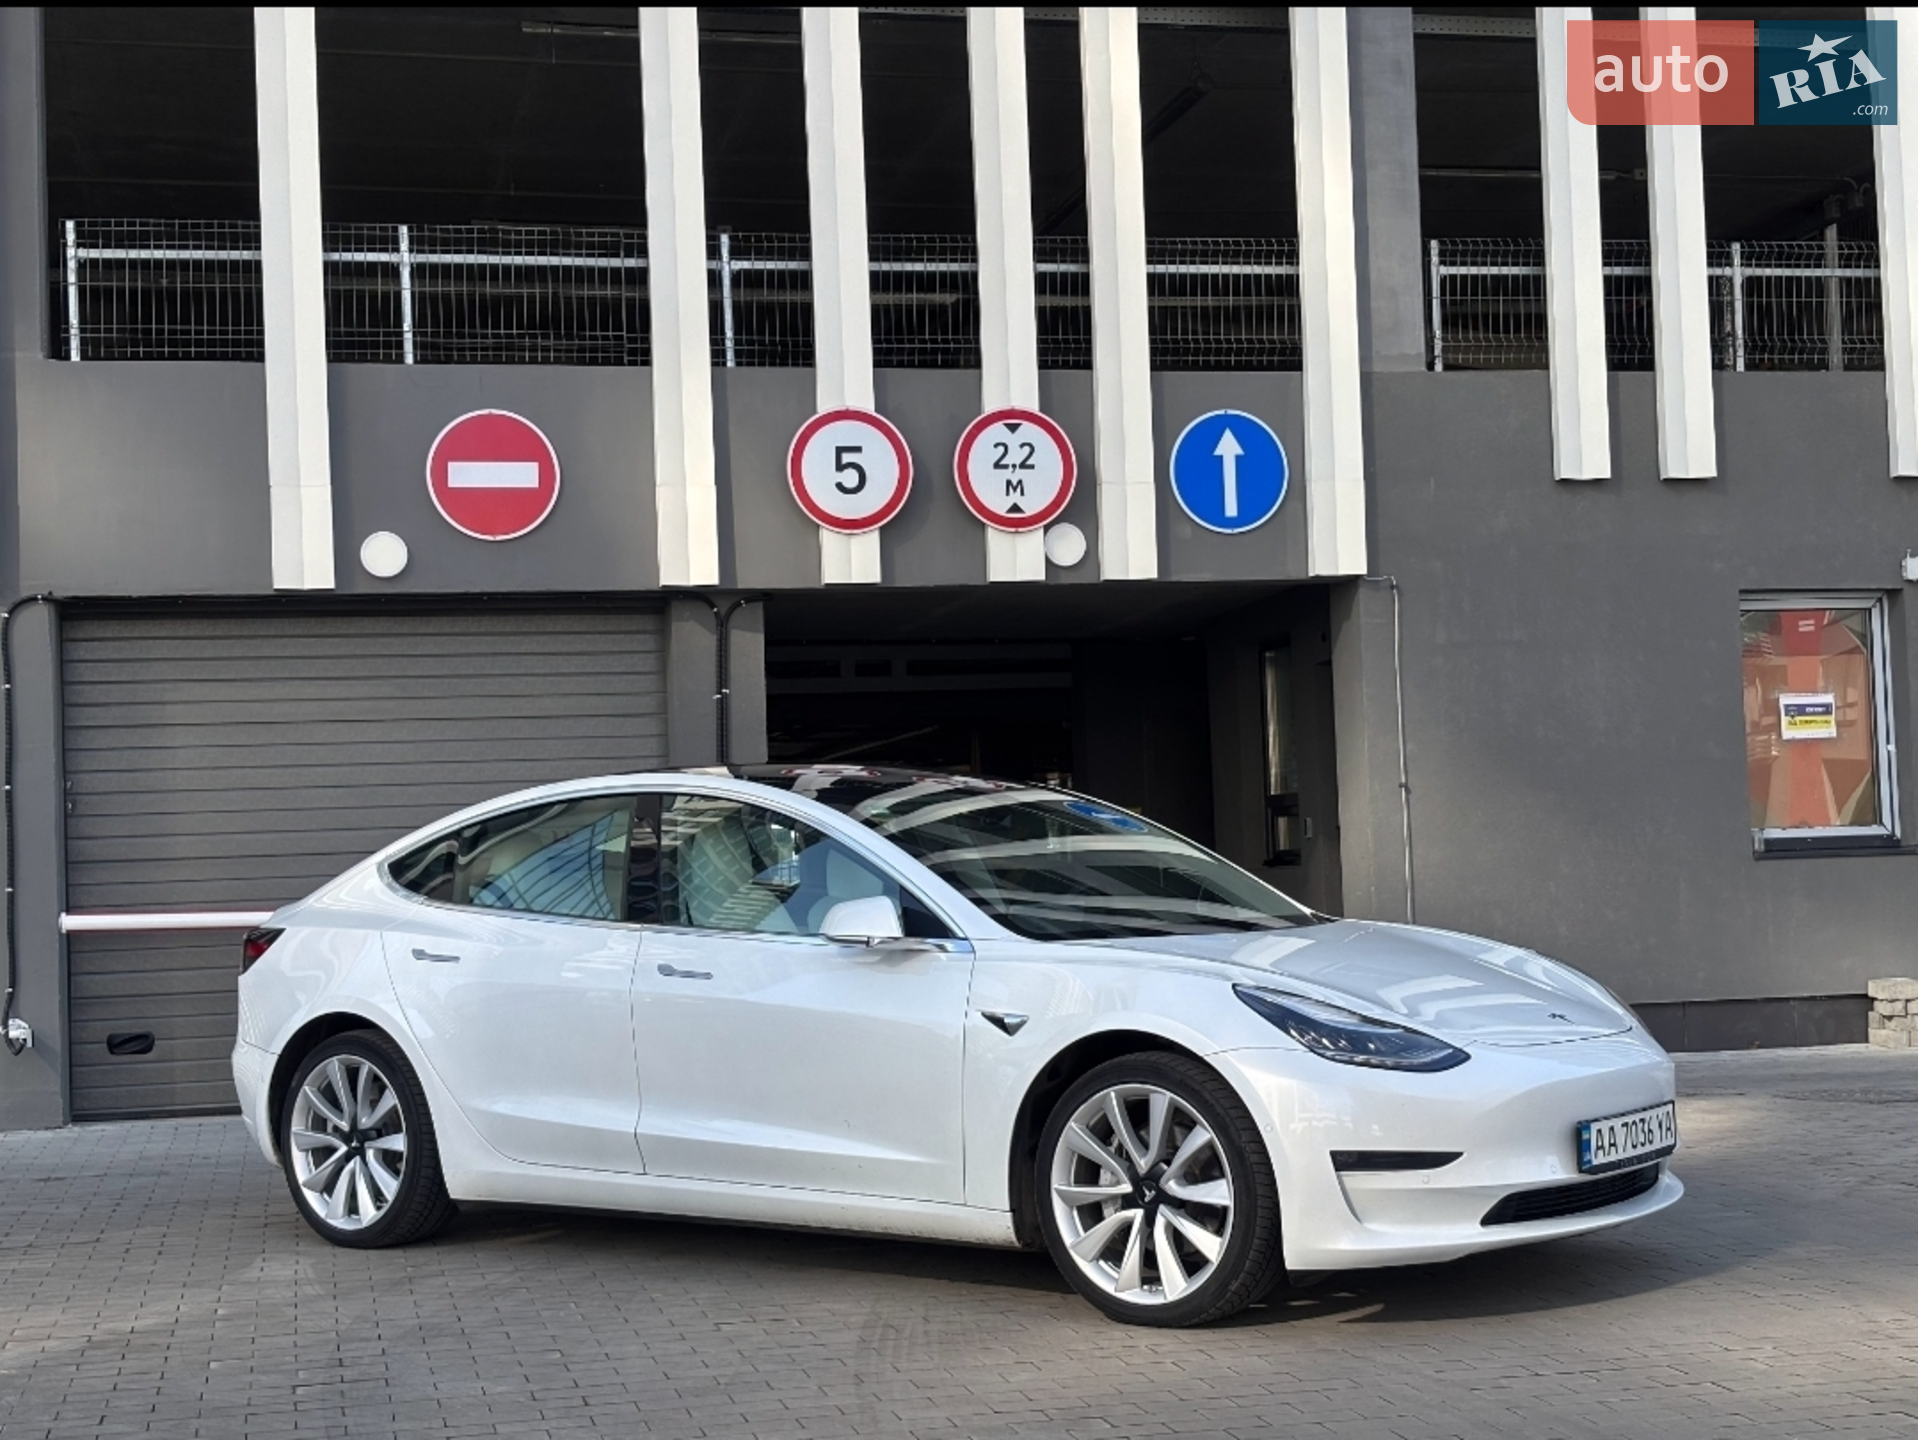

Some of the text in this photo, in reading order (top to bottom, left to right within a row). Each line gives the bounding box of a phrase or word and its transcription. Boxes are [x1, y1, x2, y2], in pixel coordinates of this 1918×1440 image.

[834, 446, 867, 495] 5
[993, 442, 1036, 473] 2,2
[1595, 1126, 1618, 1159] AA
[1621, 1117, 1654, 1152] 7036
